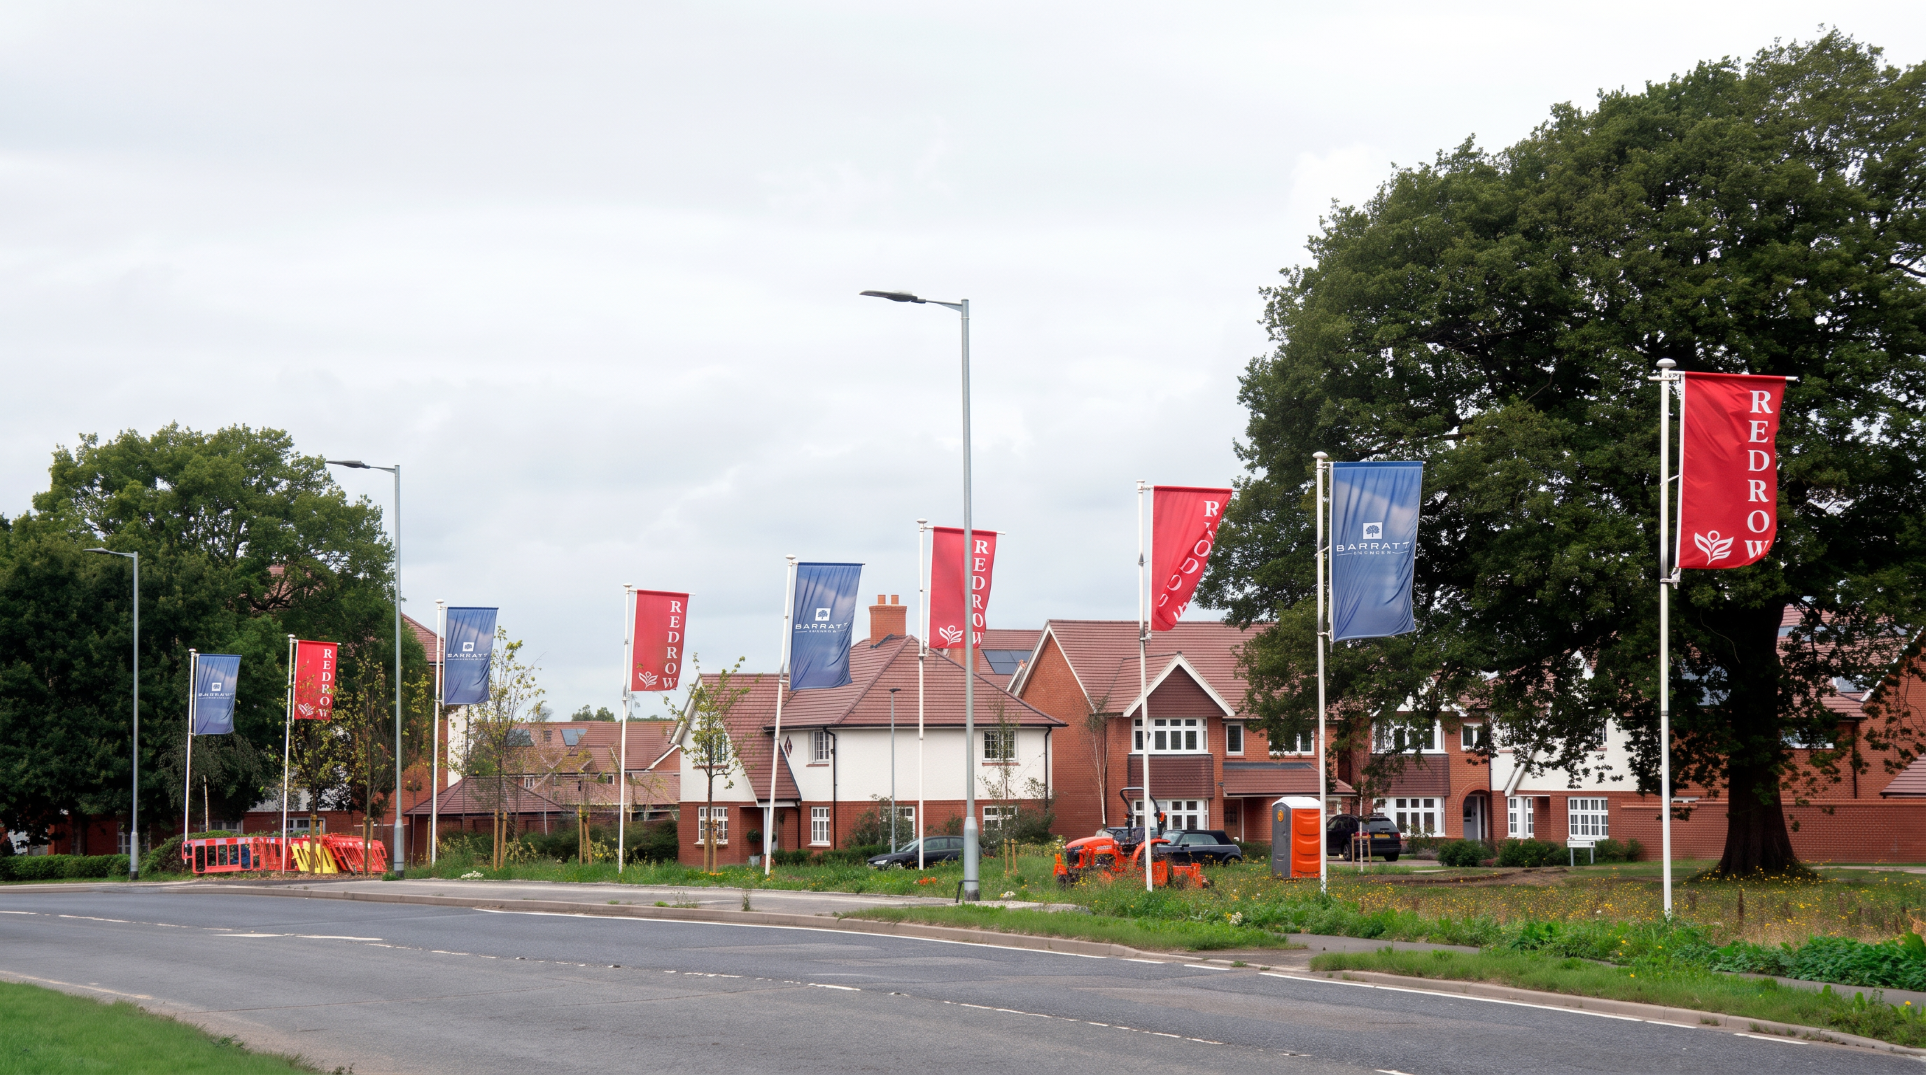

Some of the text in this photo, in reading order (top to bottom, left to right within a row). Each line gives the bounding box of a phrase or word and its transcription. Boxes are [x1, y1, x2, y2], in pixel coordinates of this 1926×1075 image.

[1744, 390, 1774, 559] REDROW
[1336, 541, 1410, 552] BARRATT
[795, 622, 848, 630] BARRATT
[971, 539, 990, 645] REDROW
[318, 648, 333, 717] REDROW
[662, 600, 682, 689] REDROW
